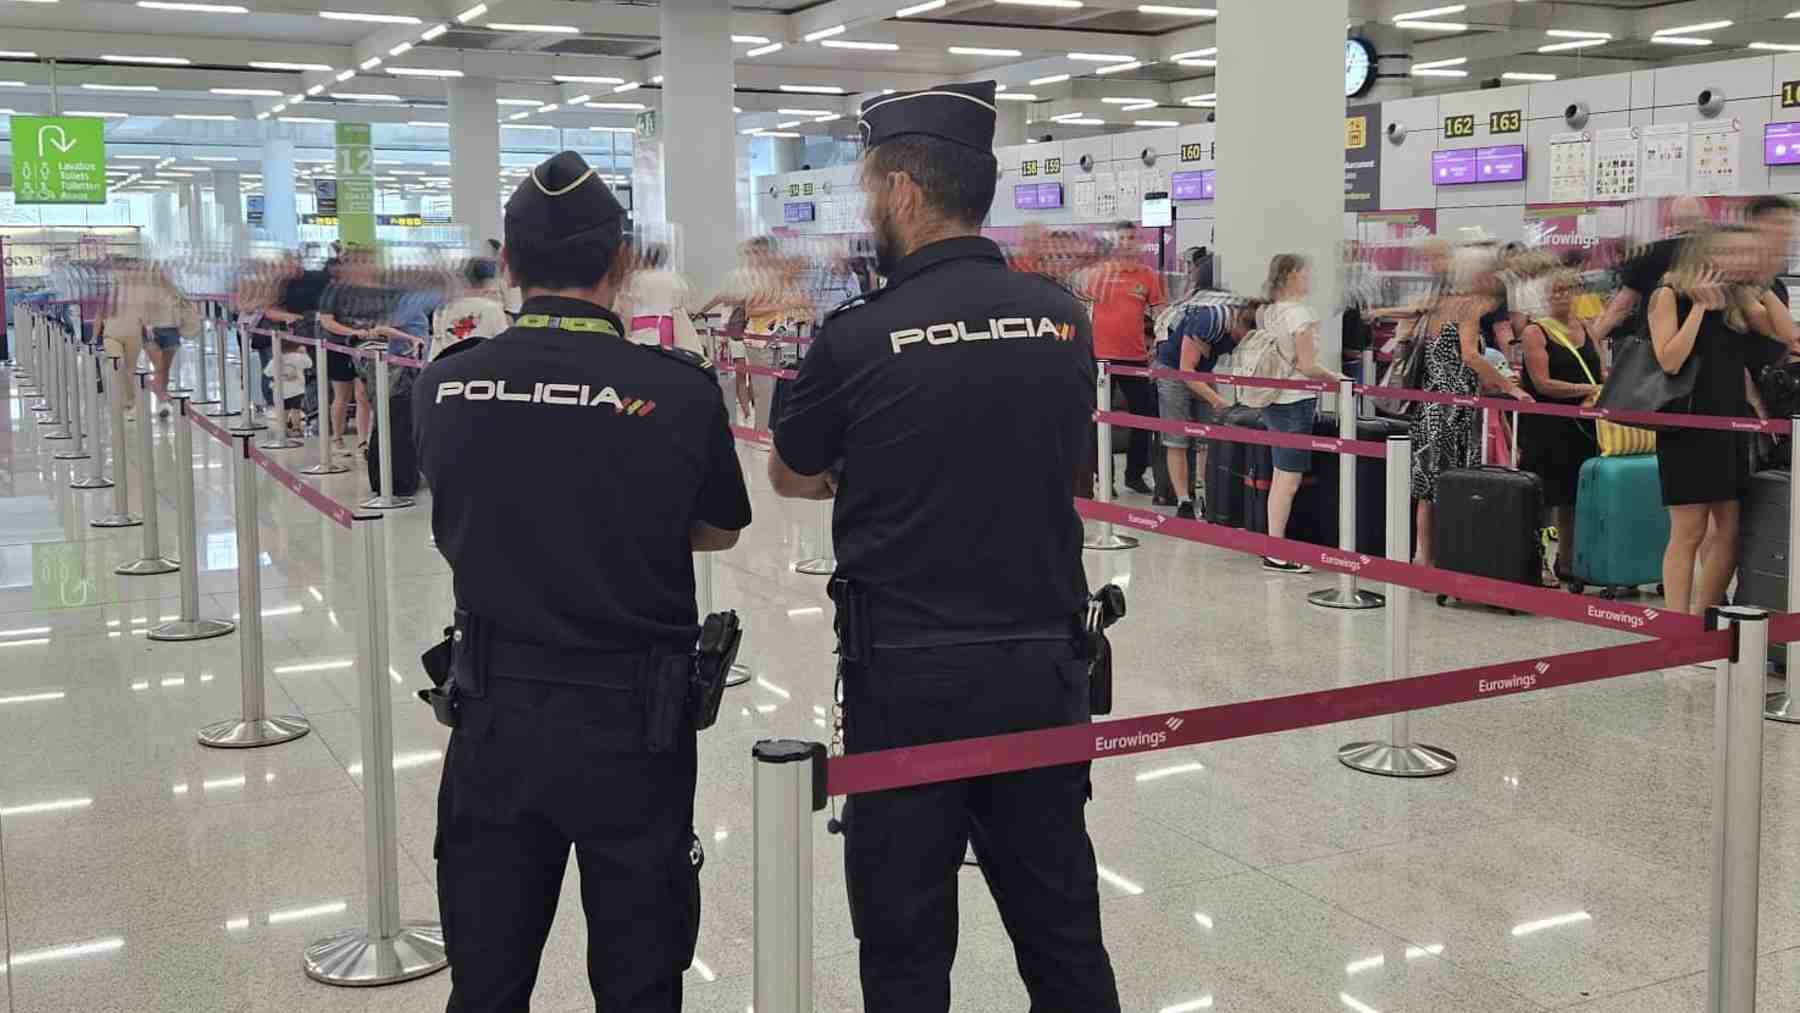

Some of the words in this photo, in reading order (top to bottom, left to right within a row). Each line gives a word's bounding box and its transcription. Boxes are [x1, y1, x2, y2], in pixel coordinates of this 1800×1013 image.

[1446, 117, 1473, 136] 162
[1491, 112, 1519, 132] 163
[341, 149, 374, 175] 12
[1182, 146, 1200, 159] 160
[890, 317, 1057, 354] POLICIA
[435, 380, 624, 410] POLICIA
[1587, 604, 1644, 628] Eurowings
[1478, 674, 1537, 693] Eurowings
[1095, 730, 1167, 751] Eurowings
